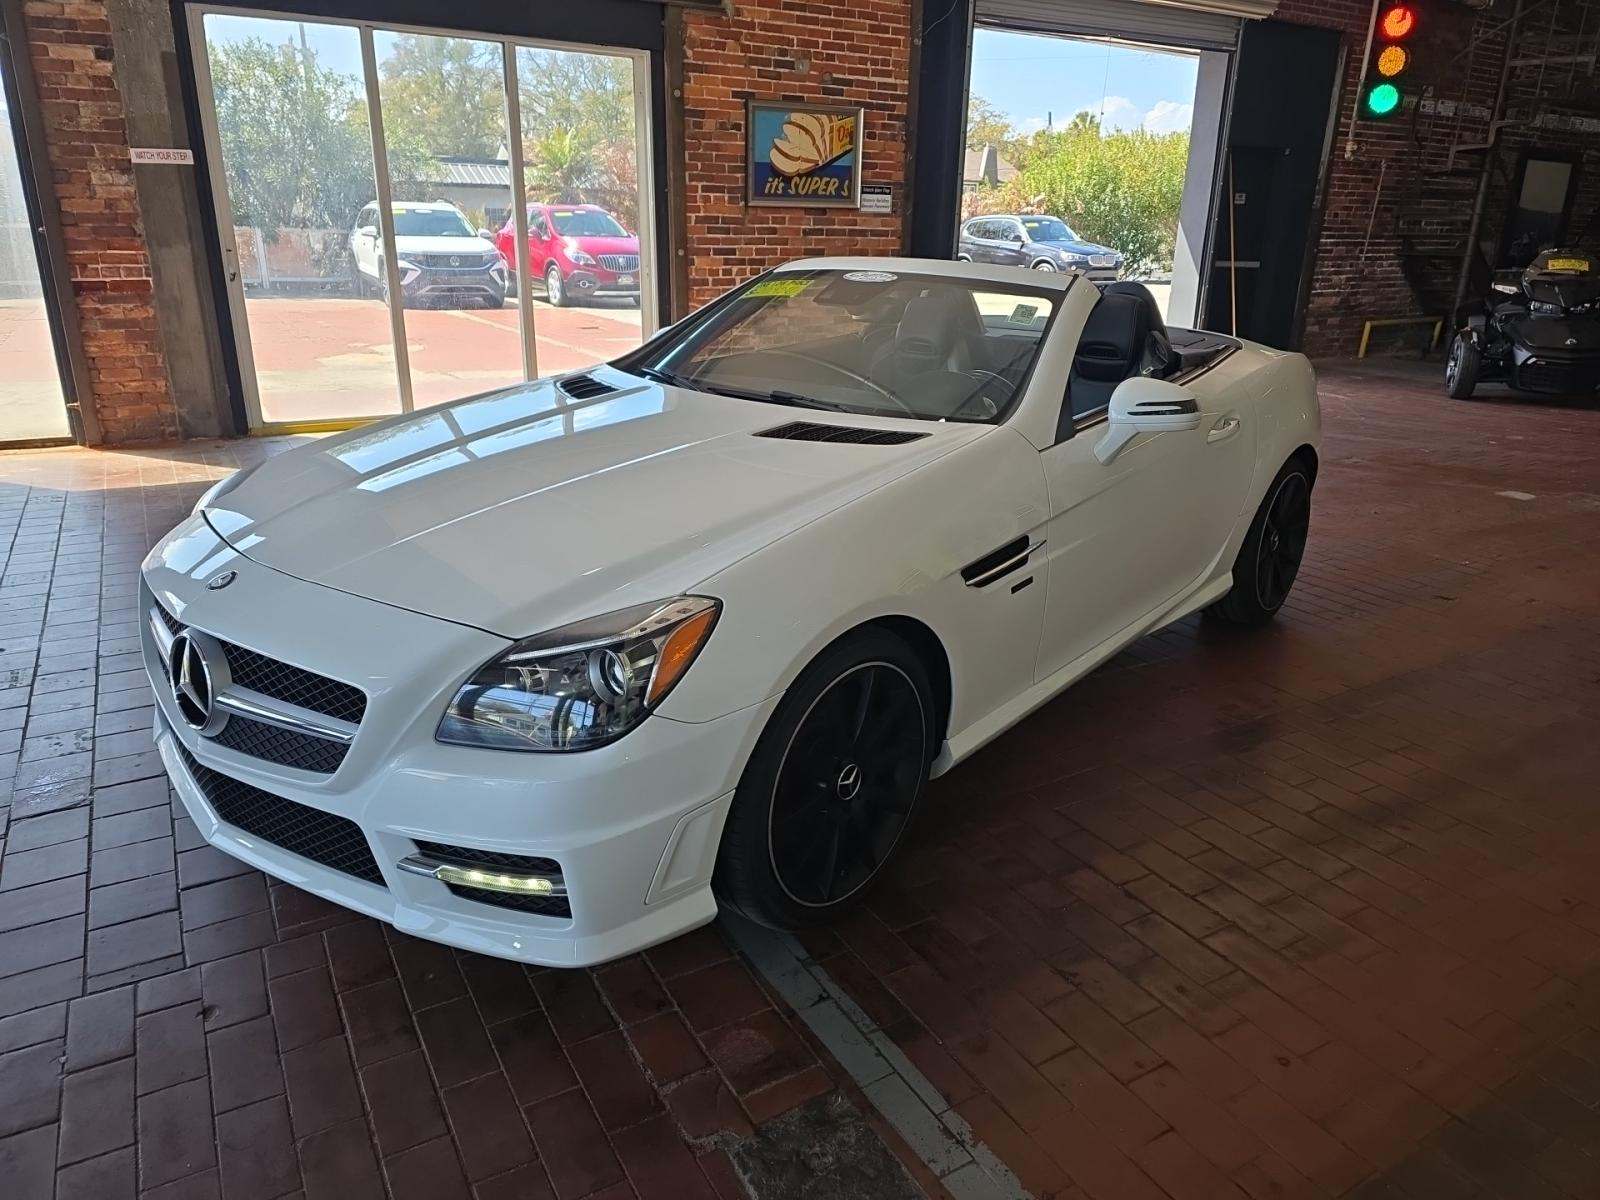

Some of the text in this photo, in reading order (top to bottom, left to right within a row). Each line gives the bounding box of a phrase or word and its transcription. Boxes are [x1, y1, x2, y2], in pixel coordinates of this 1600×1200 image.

[134, 151, 187, 160] WATCH YOUR STEP
[788, 176, 839, 195] SUPER
